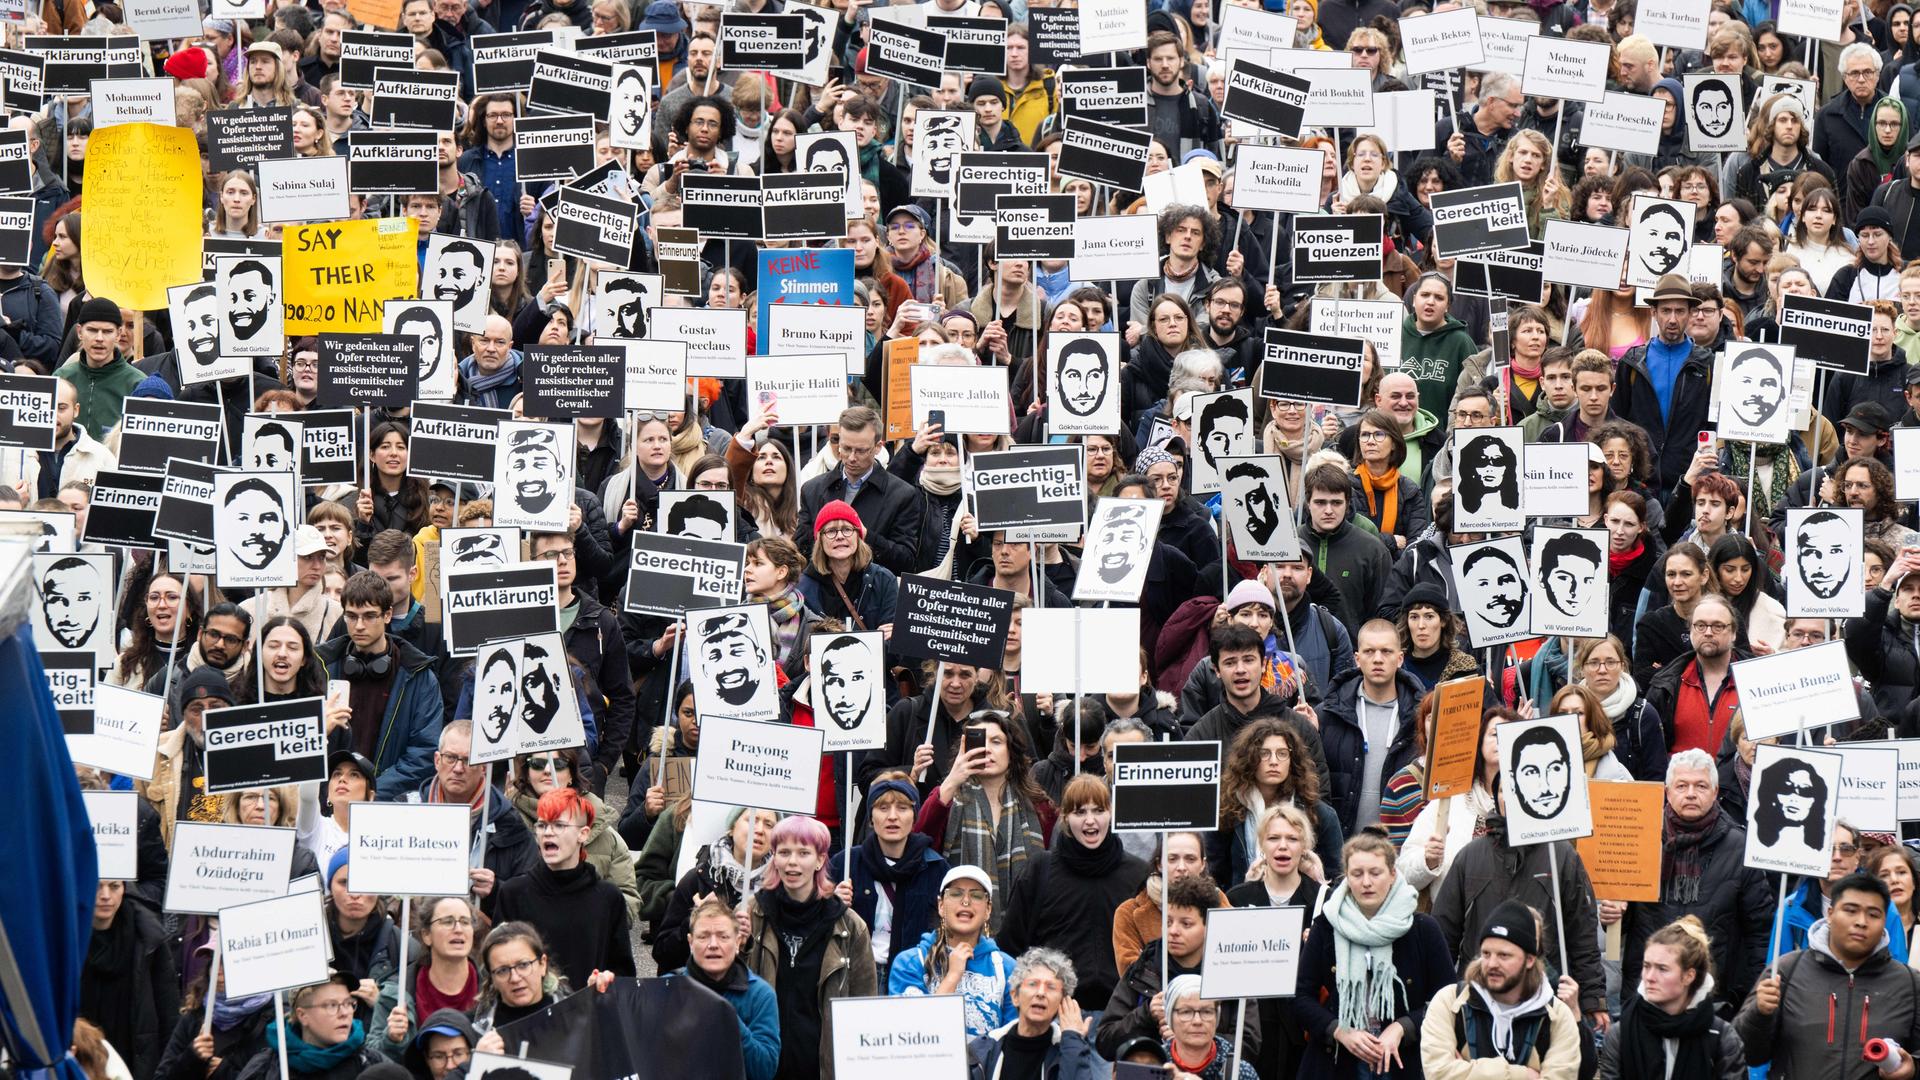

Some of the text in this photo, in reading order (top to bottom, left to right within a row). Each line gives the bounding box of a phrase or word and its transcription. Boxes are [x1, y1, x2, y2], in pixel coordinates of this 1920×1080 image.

[135, 3, 190, 16] Bernd Grigol
[725, 26, 773, 38] Konse-
[1411, 28, 1471, 46] Burak Bektaş
[739, 39, 801, 53] quenzen!
[872, 31, 915, 51] Konse-
[343, 46, 413, 60] Aufklärung!
[884, 47, 941, 68] quenzen!
[1549, 52, 1586, 65] Mehmet
[1547, 65, 1584, 79] Kubaşık
[376, 81, 456, 99] Aufklärung!
[1065, 83, 1114, 94] Konse-
[1232, 73, 1307, 105] Aufklärung!
[106, 93, 161, 103] Mohammed
[1080, 93, 1144, 107] quenzen!
[116, 104, 153, 116] Belhadj
[230, 114, 263, 125] gedenken
[1589, 108, 1658, 128] Frida Poeschke
[222, 123, 278, 135] Opfer rechter,
[218, 134, 265, 144] rassistischer
[518, 130, 593, 144] Erinnerung!
[222, 143, 282, 153] antisemitischer
[352, 144, 437, 160] Aufklärung!
[1066, 131, 1149, 159] Erinnerung!
[237, 153, 267, 162] Gewalt.
[1250, 160, 1309, 173] Jean-Daniel
[962, 167, 1043, 184] Gerechtig-
[1255, 175, 1301, 187] Makodila
[273, 179, 335, 190] Sabina Sulaj
[1016, 181, 1048, 194] keit!
[765, 188, 844, 203] Aufklärung!
[561, 201, 628, 231] Gerechtig-
[998, 211, 1045, 222] Konse-
[1435, 201, 1517, 221] Gerechtig-
[1491, 210, 1523, 227] keit!
[604, 228, 632, 243] keit!
[1011, 224, 1073, 237] quenzen!
[1297, 231, 1350, 243] Konse-
[298, 228, 342, 252] SAY
[1082, 237, 1144, 250] Jana Georgi
[659, 243, 698, 259] Erinnerung!
[1313, 244, 1379, 259] quenzen!
[1550, 242, 1619, 259] Mario Jödecke
[768, 253, 820, 276] KEINE
[310, 264, 375, 285] THEIR
[781, 278, 838, 294] Stimmen
[679, 324, 716, 336] Gustav
[1340, 323, 1371, 333] Flucht
[1785, 311, 1871, 336] Erinnerung!
[782, 327, 853, 342] Bruno Kappi
[324, 341, 341, 350] Wir
[344, 343, 382, 353] gedenken
[335, 353, 402, 365] Opfer rechter,
[531, 353, 548, 364] Wir
[551, 355, 590, 365] gedenken
[1267, 345, 1362, 368] Erinnerung!
[215, 367, 235, 377] Gürbüz
[329, 365, 408, 374] rassistischer und
[542, 365, 608, 376] Opfer rechter,
[648, 365, 677, 376] Sorce
[535, 377, 613, 386] rassistischer und
[754, 378, 840, 391] Bukurjie Haliti
[350, 387, 387, 397] Gewalt.
[539, 388, 610, 397] antisemitischer
[920, 387, 1000, 401] Sangare Jalloh
[556, 399, 592, 408] Gewalt.
[125, 416, 218, 437] Erinnerung!
[977, 469, 1073, 487] Gerechtig-
[1042, 481, 1080, 498] keit!
[635, 551, 734, 579] Gerechtig-
[699, 577, 738, 594] keit!
[453, 586, 554, 607] Aufklärung!
[907, 584, 1007, 608] Wir gedenken aller
[917, 599, 991, 621] Opfer rechter,
[908, 611, 996, 634] rassistischer und
[910, 624, 990, 645] antisemitischer
[928, 639, 968, 655] Gewalt.
[1748, 681, 1796, 701] Monica
[1800, 672, 1841, 692] Bunga
[209, 722, 315, 746] Gerechtig-
[539, 736, 571, 747] Saraçoğlu
[281, 737, 323, 755] keit!
[732, 739, 788, 760] Prayong
[725, 758, 792, 780] Rungjang
[1118, 762, 1218, 783] Erinnerung!
[1842, 777, 1886, 790] Wisser
[360, 836, 460, 850] Kajrat Batesov
[191, 845, 275, 863] Abdurrahim
[1752, 855, 1821, 872] Mercedes Kierpacz
[197, 864, 263, 883] Özüdoğru
[228, 923, 318, 953] Rabia El Omari
[1215, 938, 1290, 954] Antonio Melis
[860, 1031, 939, 1047] Karl Sidon
